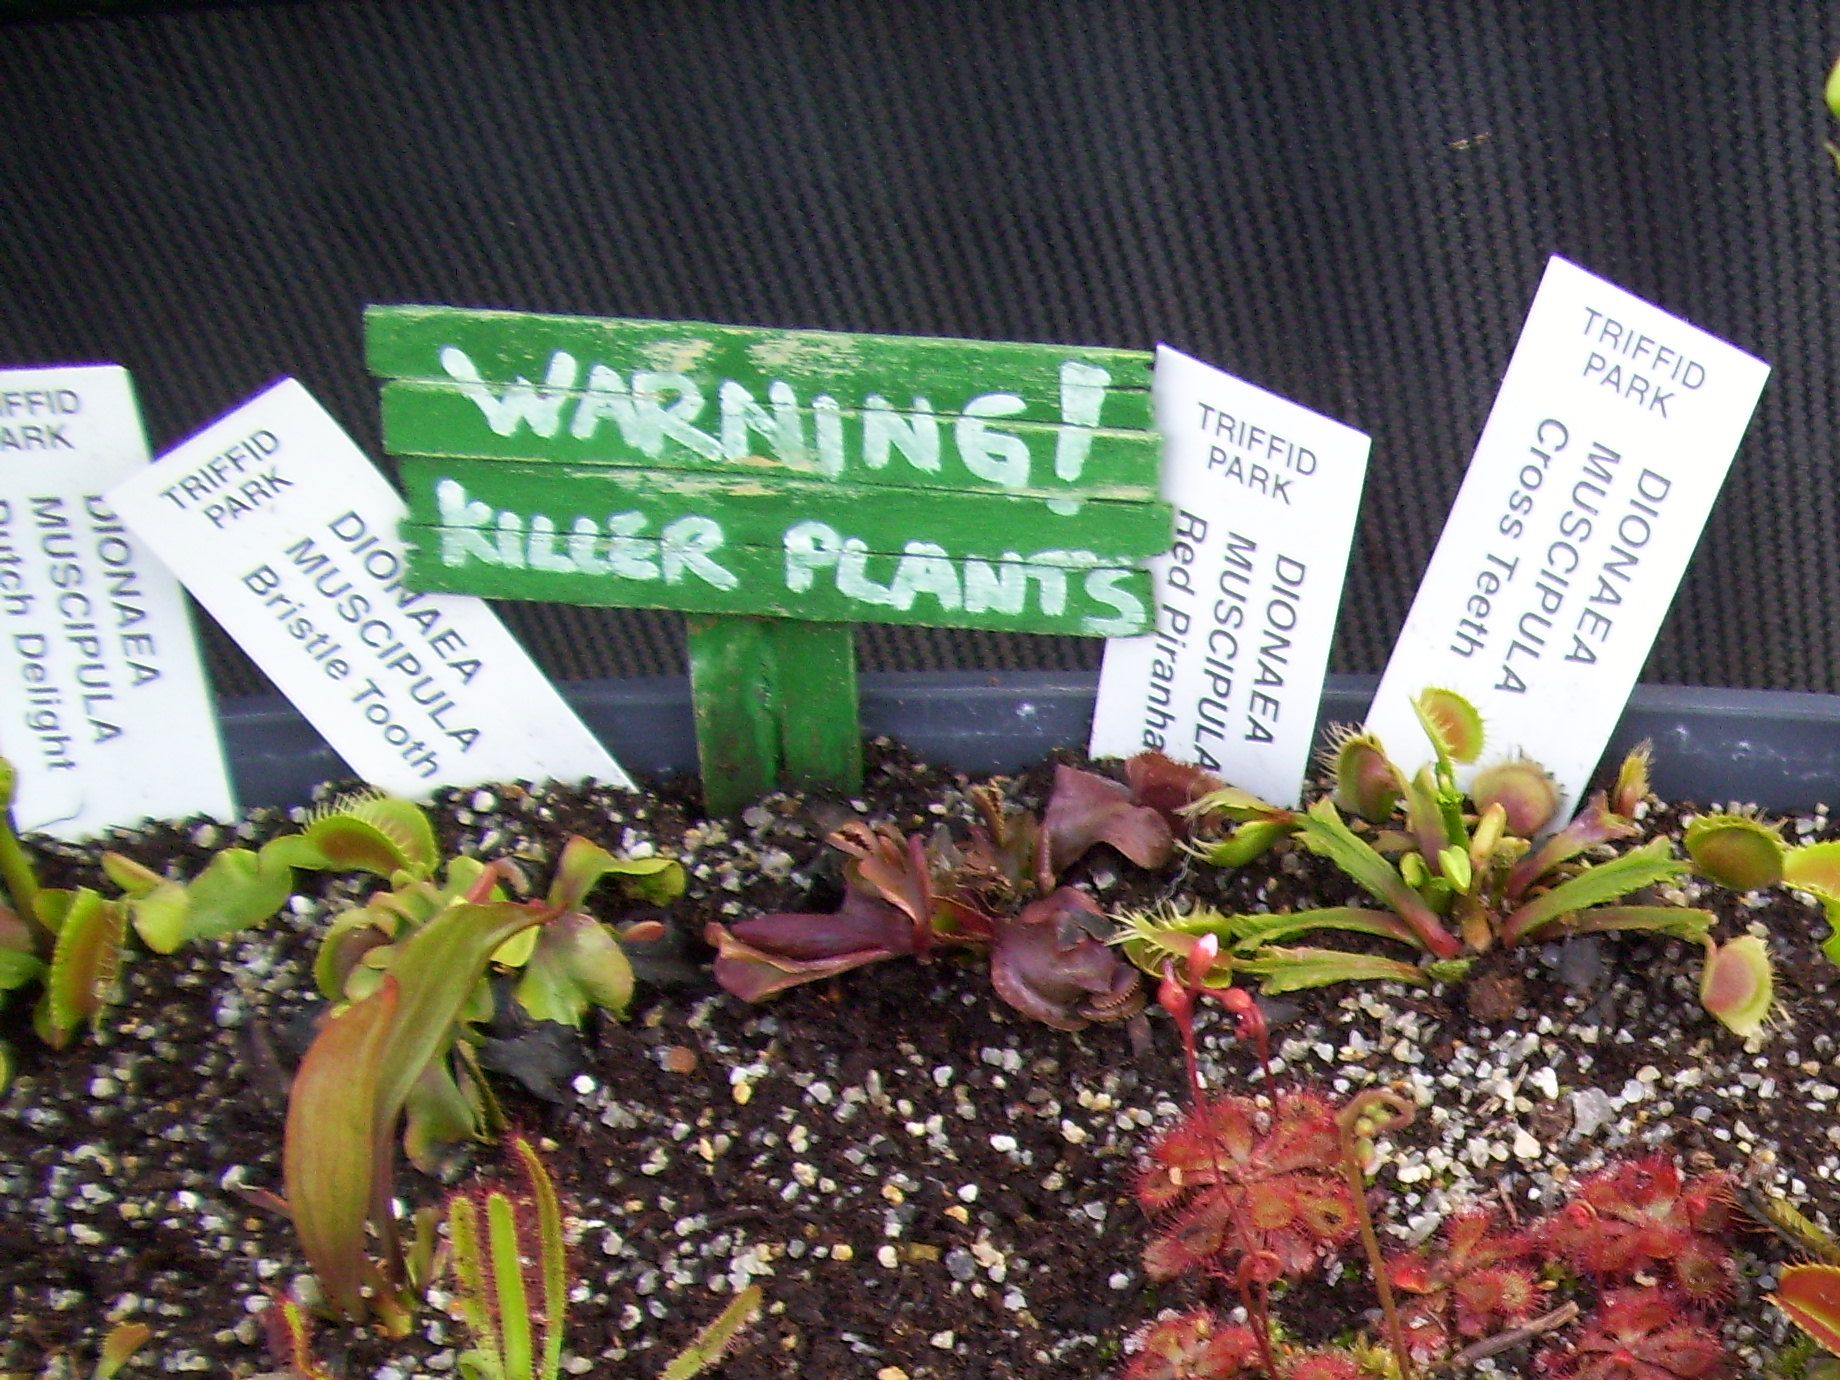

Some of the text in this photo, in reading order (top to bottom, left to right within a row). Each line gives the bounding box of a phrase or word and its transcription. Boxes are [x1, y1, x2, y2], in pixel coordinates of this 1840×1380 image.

[0, 388, 81, 415] FFID
[438, 342, 1112, 517] WARNING!
[1582, 306, 1707, 392] TRIFFID
[1582, 352, 1676, 419] PARK
[0, 424, 76, 450] ARK
[159, 429, 281, 510] TRIFFID
[202, 465, 295, 529] PARK
[1198, 402, 1319, 477] TRIFFID
[1207, 445, 1296, 505] PARK
[29, 497, 124, 744] MUSCIPULA
[436, 477, 1150, 638] KILLER PLANTS
[1449, 417, 1570, 658] Cross Teeth
[1494, 440, 1622, 697] MUSCIPULA
[1564, 467, 1673, 667] DIONAEA
[14, 633, 77, 770] Delight
[241, 564, 441, 779] Bristle Tooth
[284, 537, 481, 753] MUSCIPULA
[1142, 509, 1208, 752] Red Piranha
[1193, 531, 1259, 772] MUSCIPULA
[1244, 553, 1307, 745] DIONAEA
